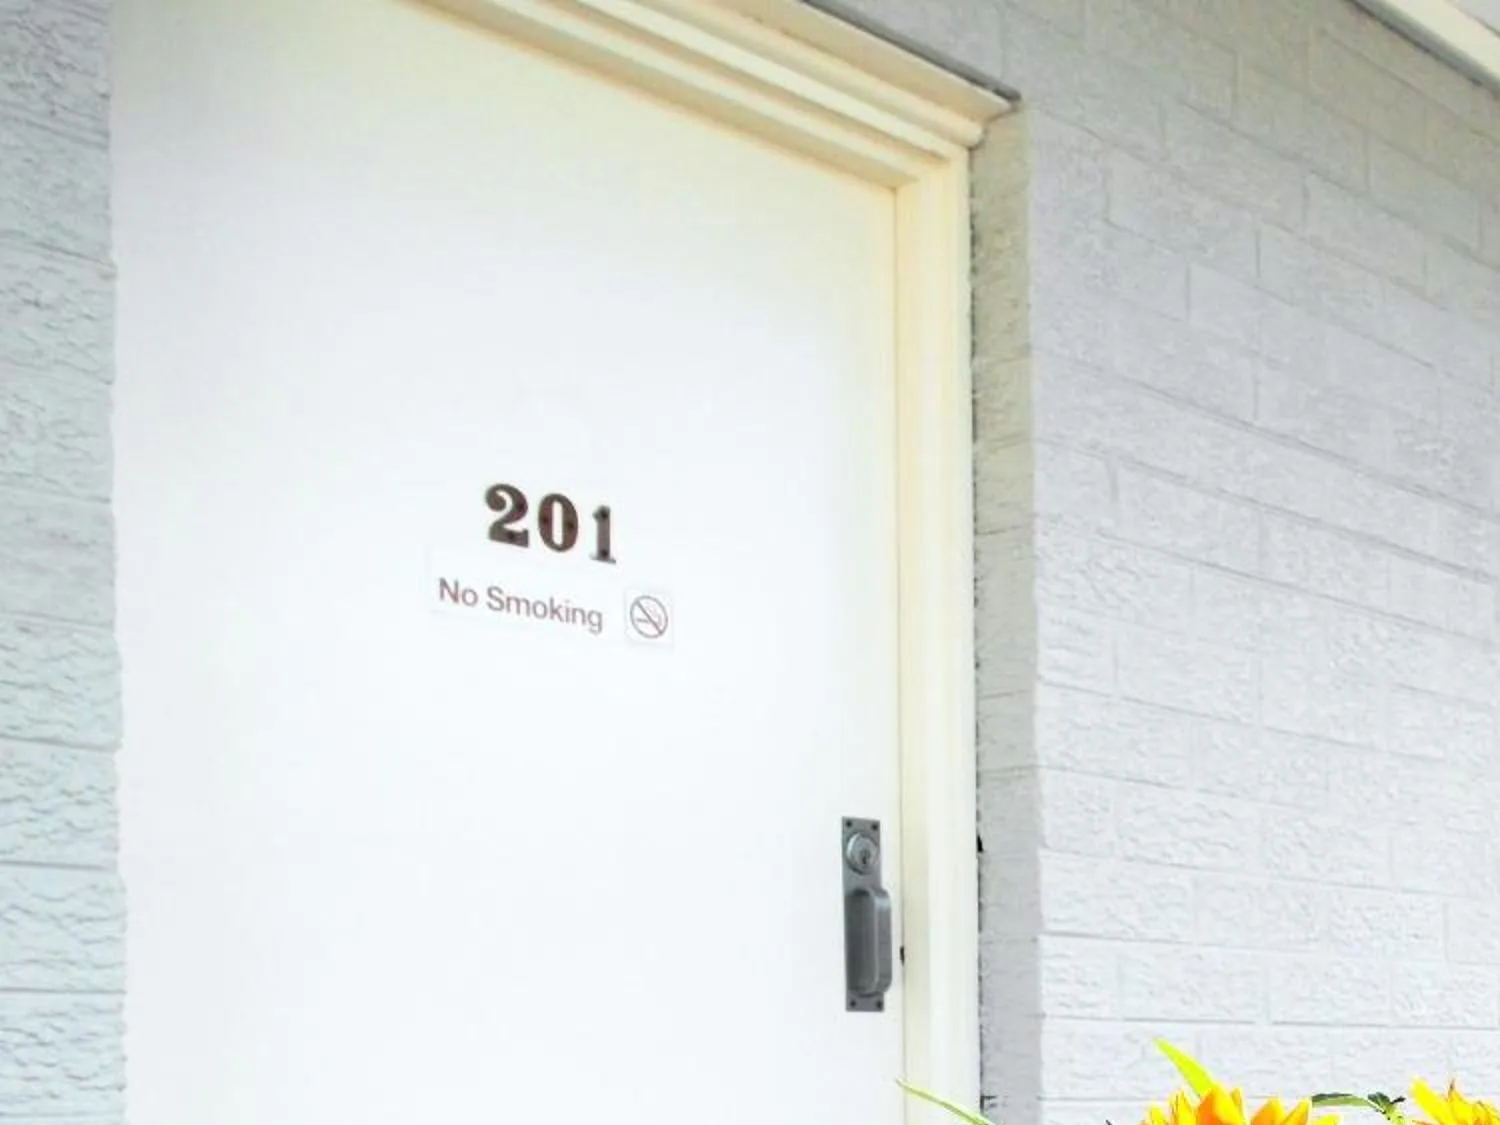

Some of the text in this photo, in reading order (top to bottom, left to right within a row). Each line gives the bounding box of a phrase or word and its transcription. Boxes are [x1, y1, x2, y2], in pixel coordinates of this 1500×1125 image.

[484, 483, 616, 564] 201
[438, 577, 603, 635] No Smoking
